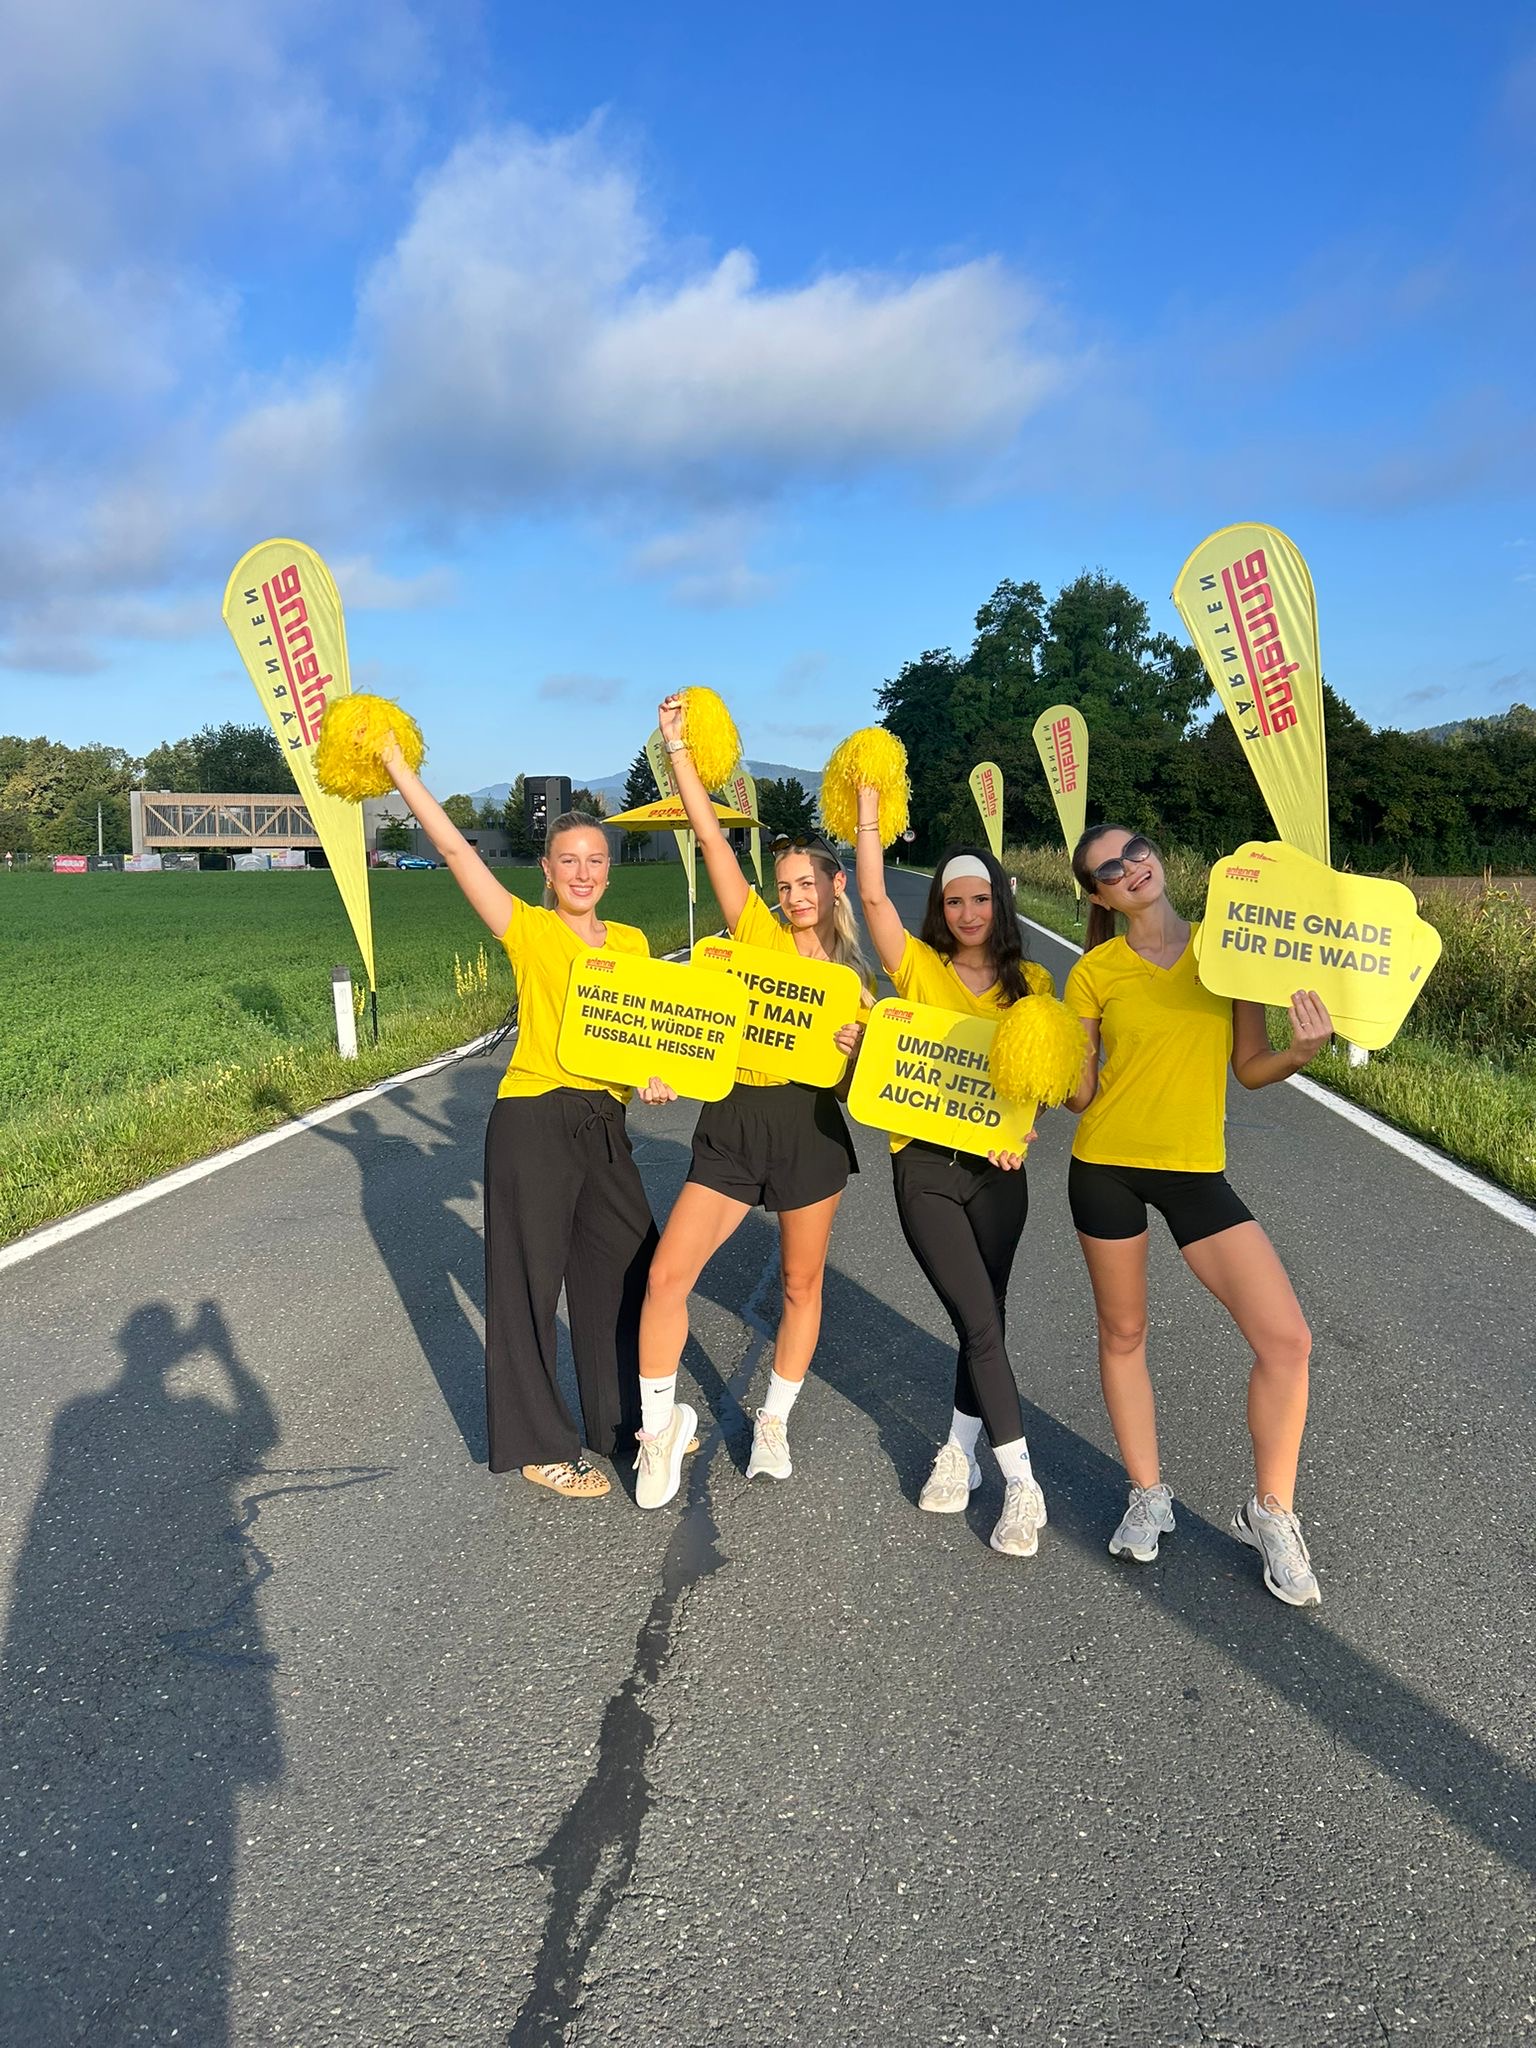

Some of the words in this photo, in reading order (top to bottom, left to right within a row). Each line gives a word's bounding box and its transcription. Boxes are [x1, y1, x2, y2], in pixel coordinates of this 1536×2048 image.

[1226, 866, 1260, 877] antenne
[1227, 901, 1297, 930] KEINE
[1303, 914, 1392, 947] GNADE
[1221, 927, 1267, 955] FÜR
[1273, 938, 1313, 962] DIE
[1319, 945, 1391, 975] WADE
[577, 984, 619, 1004] WÄRE
[622, 994, 646, 1009] EIN
[650, 999, 736, 1027] MARATHON
[581, 1005, 647, 1030] EINFACH,
[651, 1018, 703, 1040] WÜRDE
[707, 1029, 725, 1044] ER
[763, 1003, 813, 1029] MAN
[584, 1024, 652, 1048] FUSSBALL
[656, 1038, 715, 1061] HEISSEN
[742, 1025, 796, 1051] RIEFE
[896, 1059, 942, 1087] WÄR
[879, 1083, 941, 1113] AUCH
[945, 1099, 1001, 1127] BLÖD
